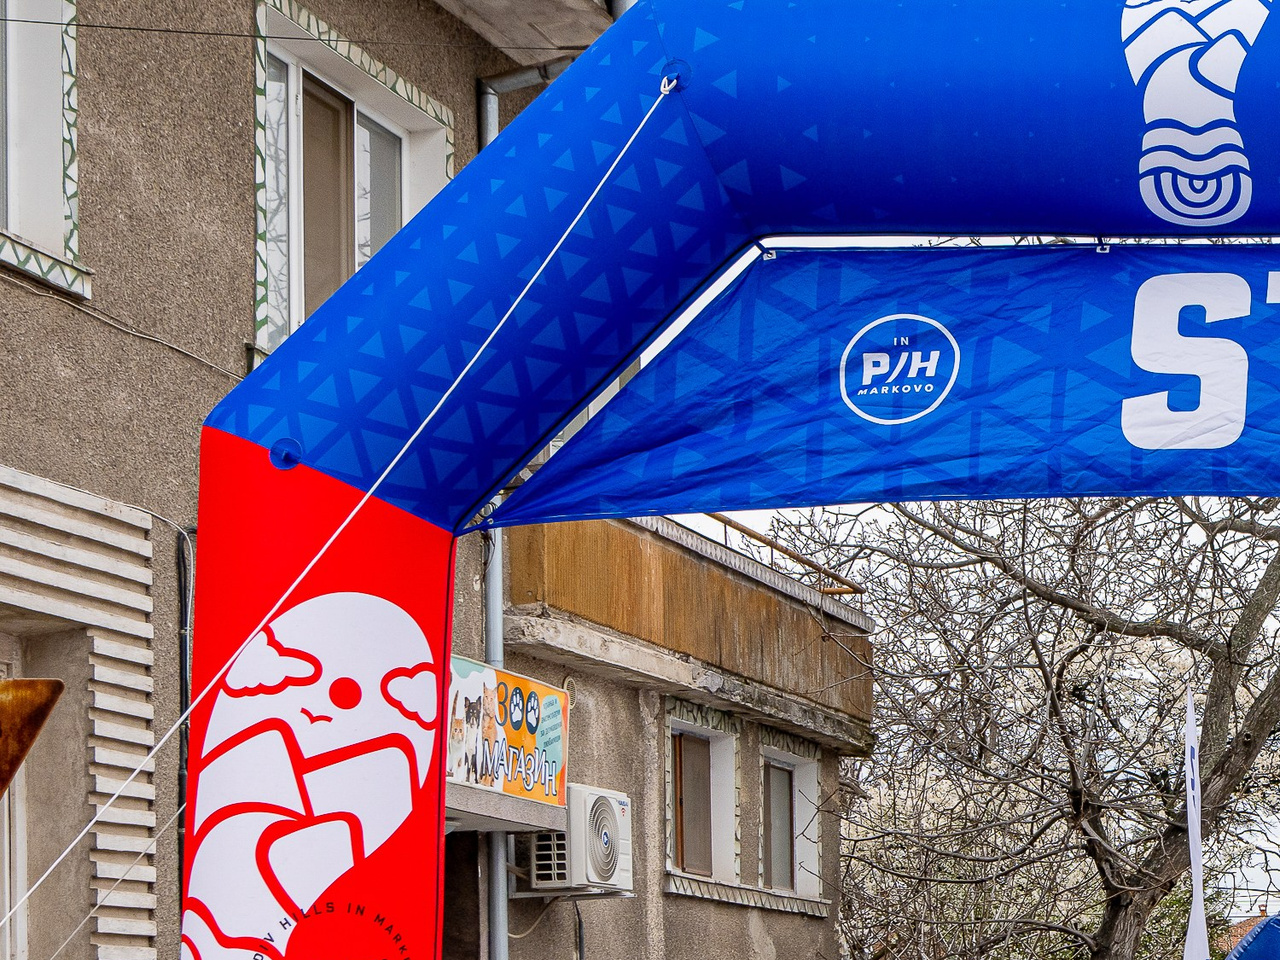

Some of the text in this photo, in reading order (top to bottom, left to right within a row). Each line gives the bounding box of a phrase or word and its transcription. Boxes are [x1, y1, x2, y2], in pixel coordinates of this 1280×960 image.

[893, 336, 909, 346] IN
[862, 350, 940, 386] P/H
[857, 384, 934, 396] MARKOVO
[279, 902, 336, 930] HILLS
[347, 903, 366, 916] IN
